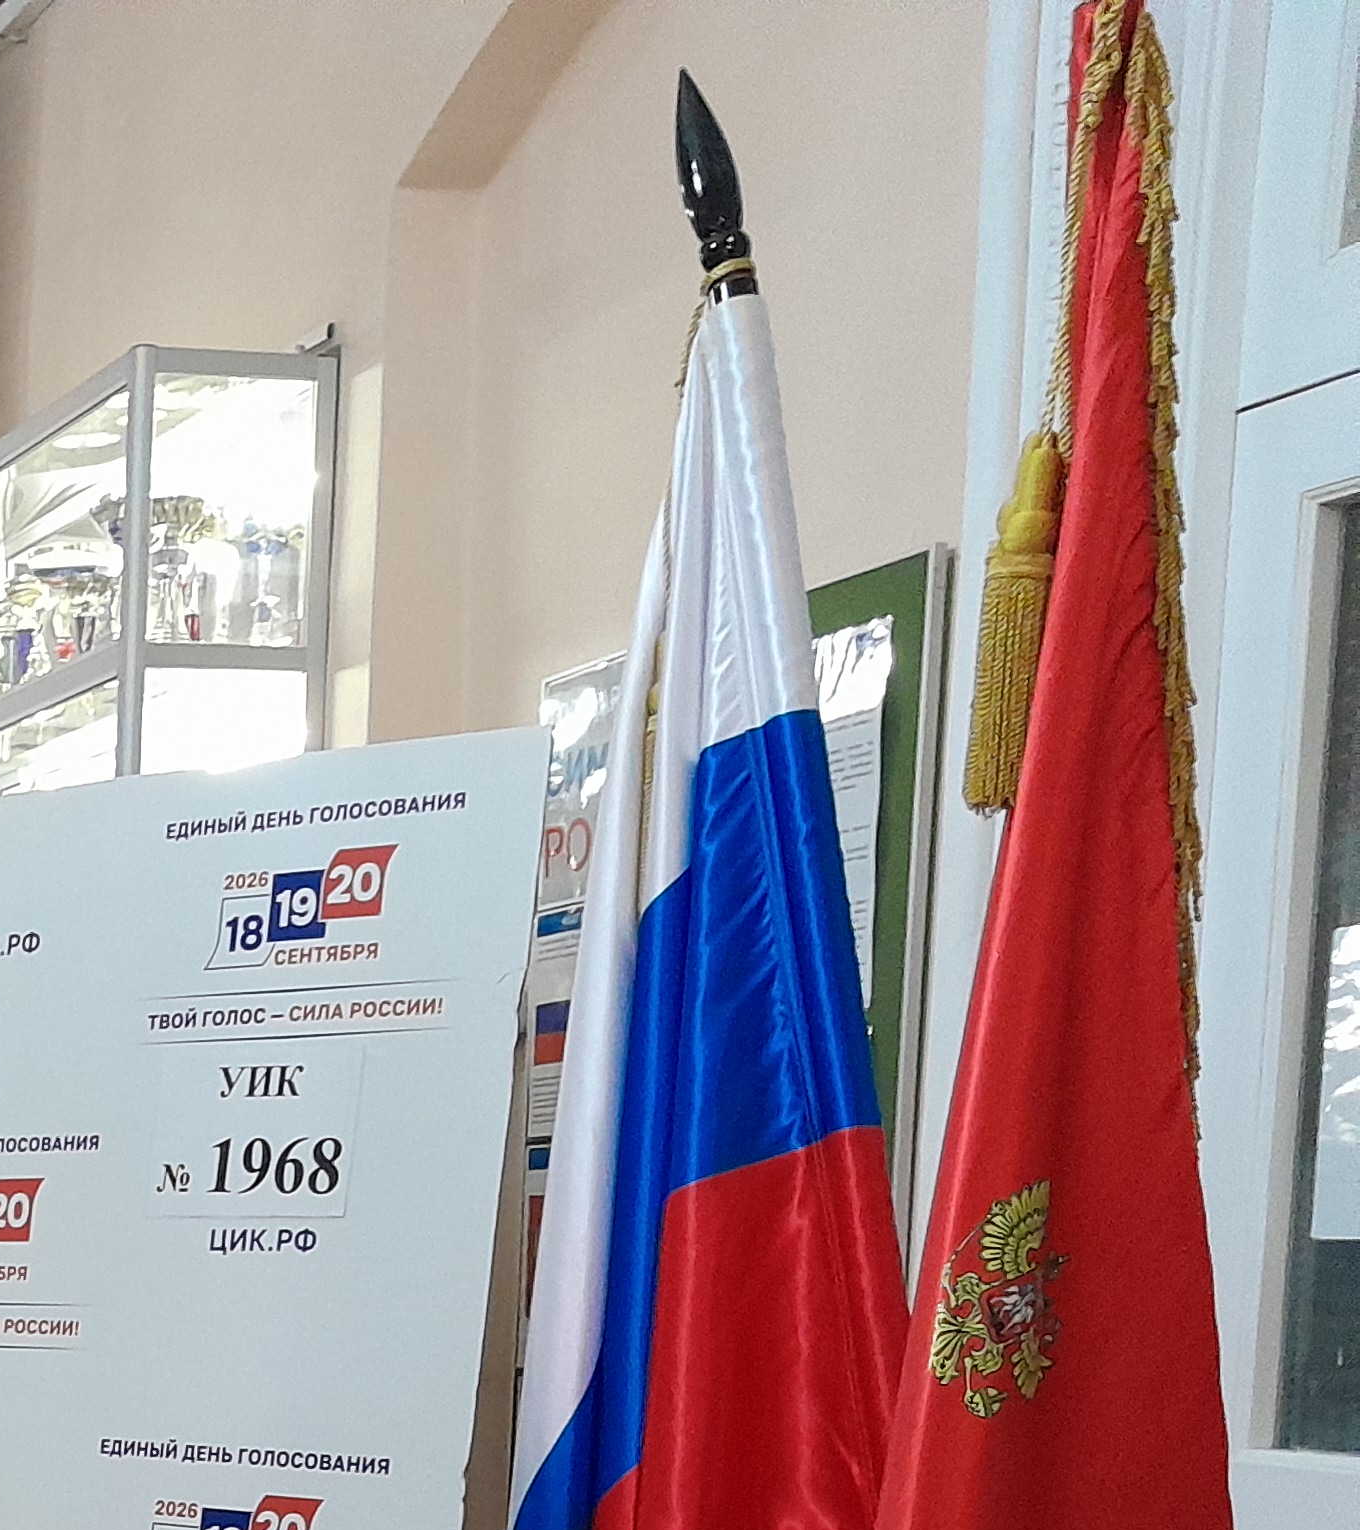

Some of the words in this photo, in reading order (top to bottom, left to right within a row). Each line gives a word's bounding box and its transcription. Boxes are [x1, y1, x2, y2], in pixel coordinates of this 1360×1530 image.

[166, 811, 247, 841] ЕДИНЫЙ
[251, 809, 303, 832] ДЕНЬ
[309, 792, 466, 825] ГОЛОСОВАНИЯ
[223, 872, 268, 890] 2026
[226, 915, 263, 952] 18
[275, 888, 316, 928] 19
[327, 862, 380, 904] 20
[275, 943, 378, 965] СЕНТЯБРЯ
[148, 1009, 197, 1030] ТВОЙ
[202, 1008, 266, 1027] ГОЛОС
[289, 1004, 343, 1022] СИЛА
[350, 998, 443, 1018] РОССИИ!
[220, 1066, 304, 1098] УИК
[157, 1164, 190, 1192] №
[207, 1138, 342, 1194] 1968
[209, 1228, 317, 1255] ЦИК.РФ
[4, 1319, 79, 1336] РОССИИ!
[100, 1439, 177, 1459] ЕДИНЫЙ
[182, 1444, 231, 1463] ДЕНЬ
[237, 1448, 390, 1475] ГОЛОСОВАНИЯ
[154, 1500, 198, 1518] 2026
